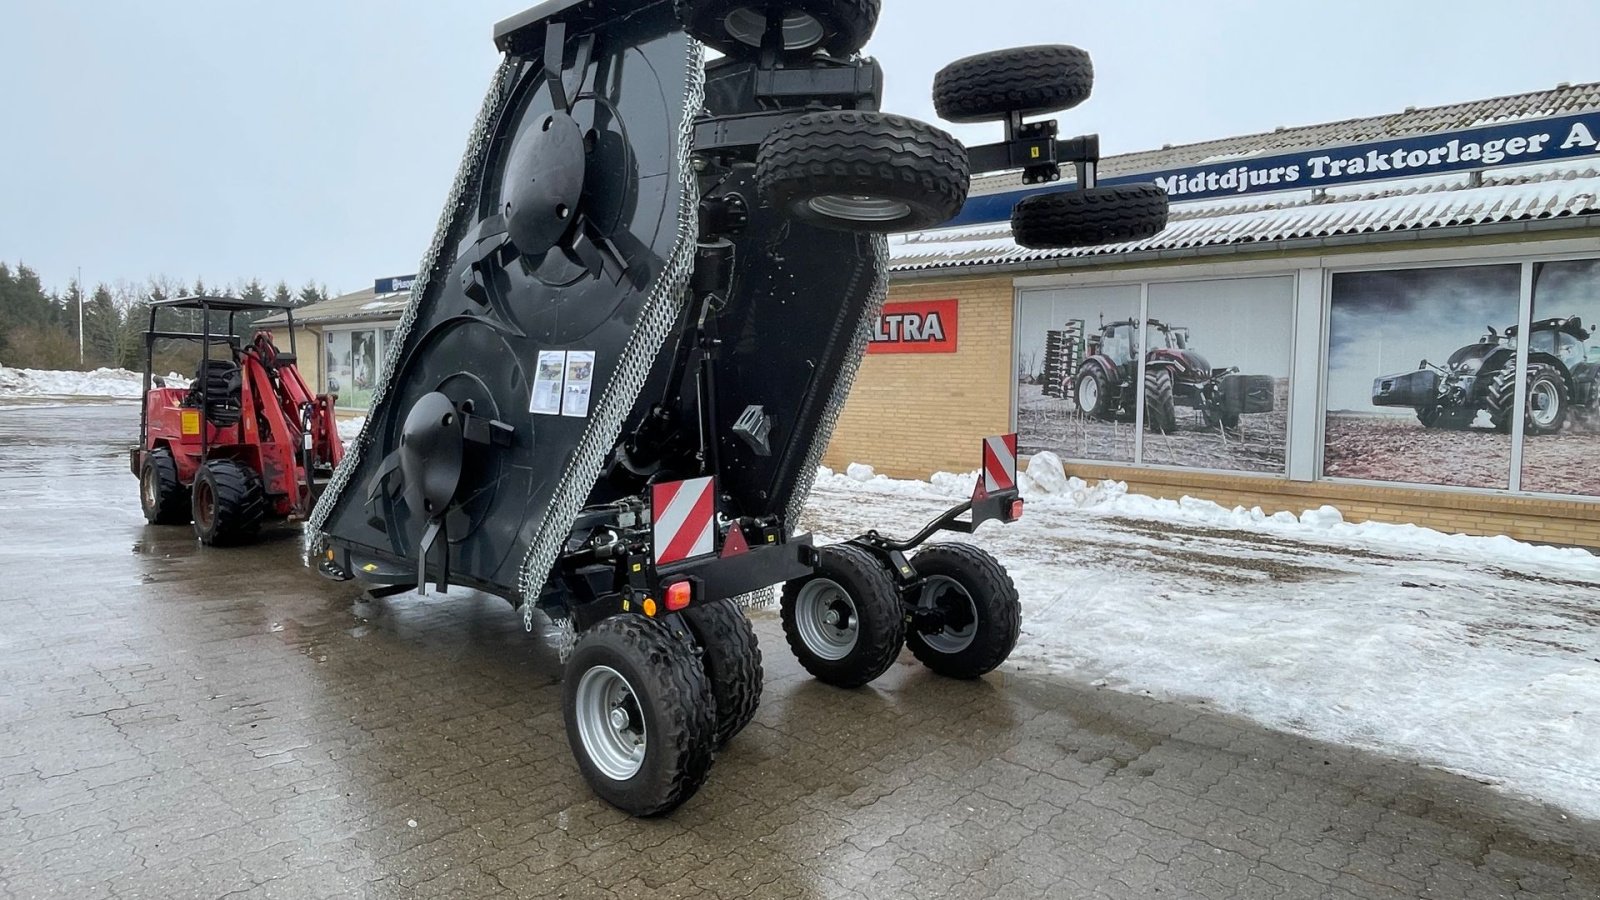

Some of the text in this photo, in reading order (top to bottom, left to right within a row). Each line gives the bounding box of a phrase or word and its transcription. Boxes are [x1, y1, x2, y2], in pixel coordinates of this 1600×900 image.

[1155, 165, 1300, 195] Midtdjurs
[1308, 133, 1550, 179] Traktorlager
[868, 313, 945, 342] LTRA
